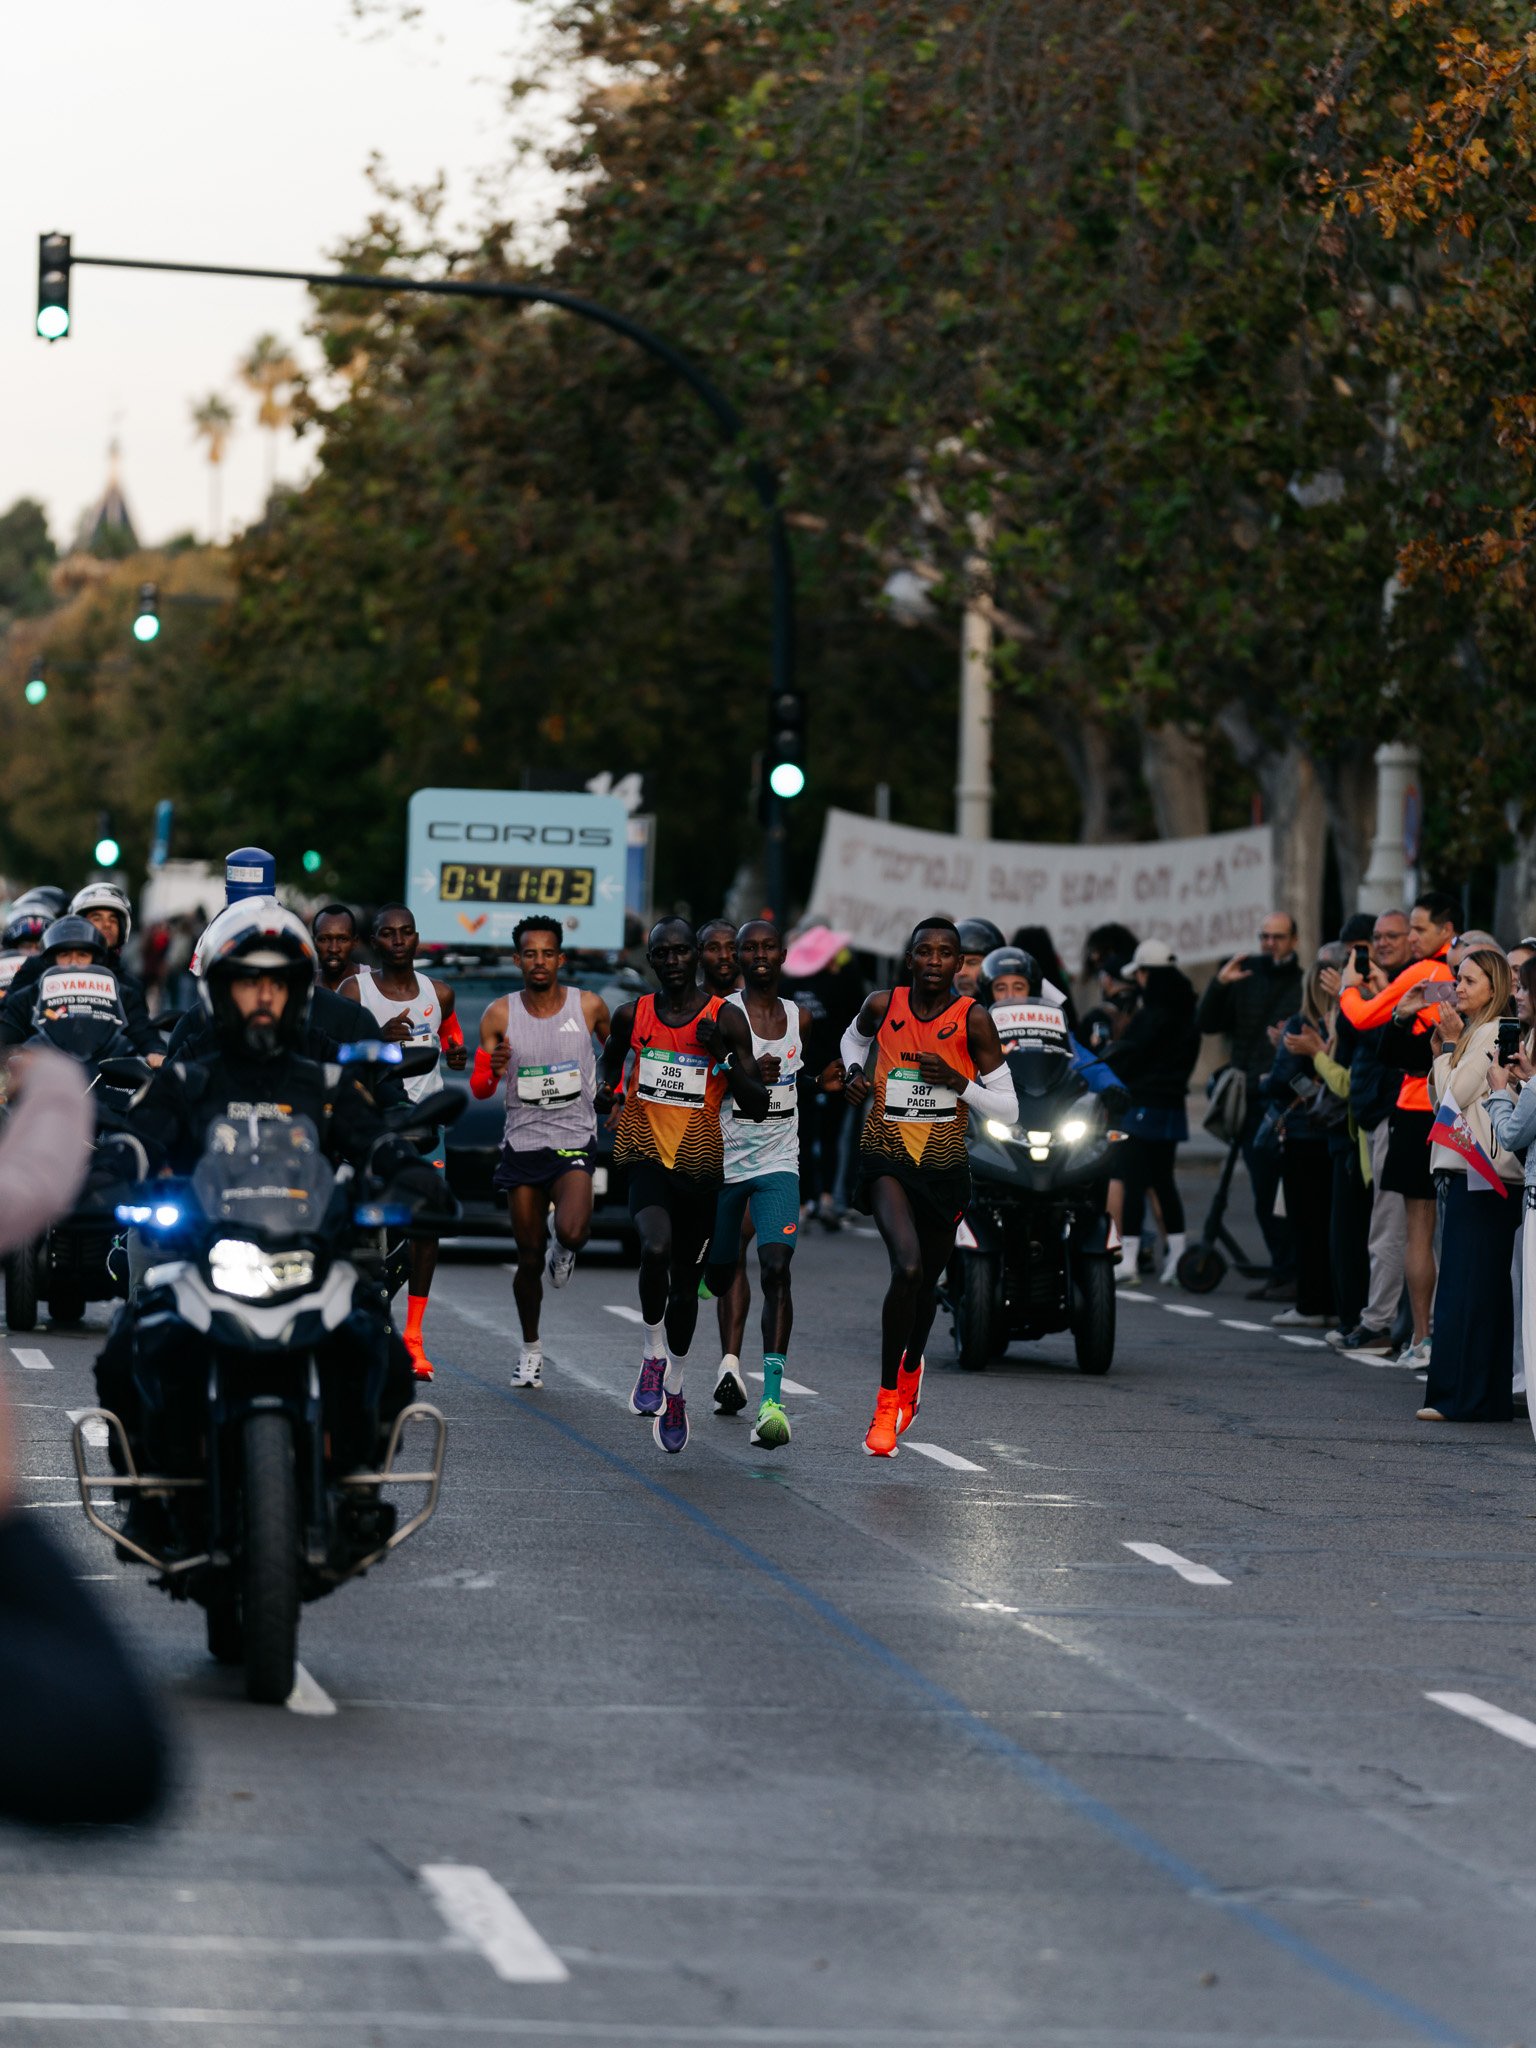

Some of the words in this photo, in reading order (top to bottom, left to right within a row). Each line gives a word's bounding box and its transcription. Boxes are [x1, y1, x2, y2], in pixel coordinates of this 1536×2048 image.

[428, 821, 612, 847] COROS
[441, 865, 592, 906] 0:41:03
[62, 979, 112, 993] YAMAHA
[47, 996, 75, 1007] MOTO
[1011, 1012, 1061, 1025] YAMAHA
[661, 1065, 682, 1078] 385
[542, 1077, 555, 1087] 26
[656, 1078, 685, 1091] PACER
[541, 1088, 560, 1097] DIDA
[912, 1085, 933, 1096] 387
[768, 1101, 781, 1110] RIR
[907, 1098, 936, 1108] PACER
